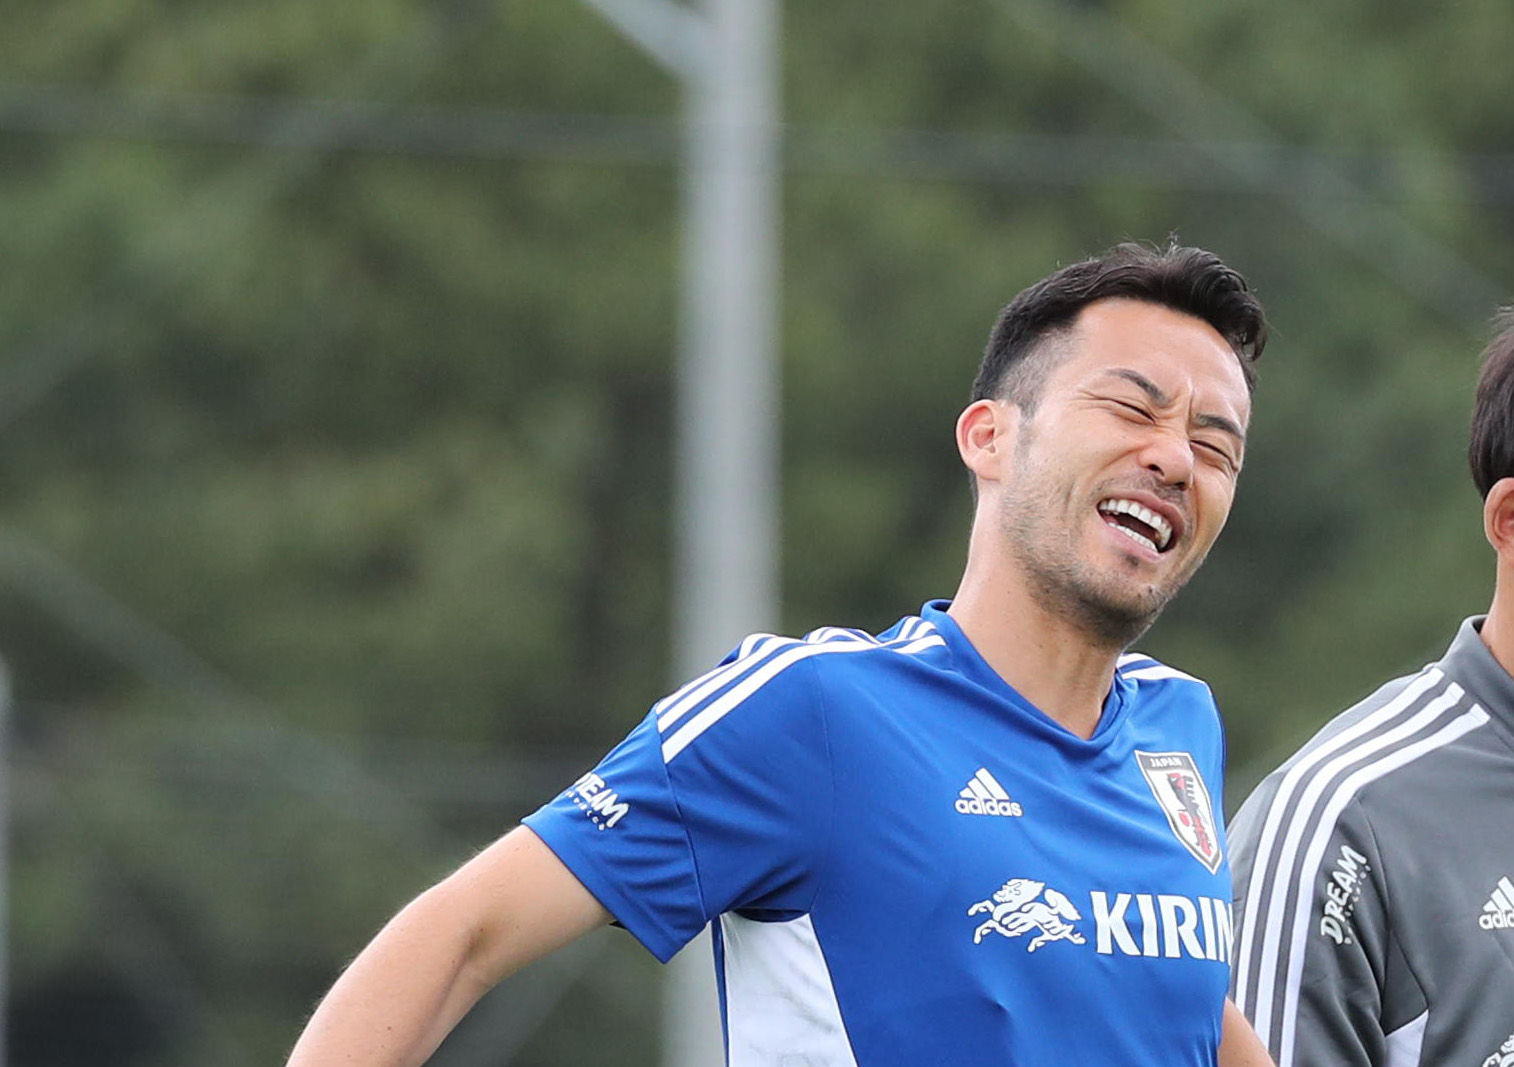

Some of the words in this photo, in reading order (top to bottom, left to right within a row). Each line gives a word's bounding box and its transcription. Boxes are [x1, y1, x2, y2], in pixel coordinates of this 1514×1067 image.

[1149, 757, 1183, 768] JAPAN
[955, 798, 1023, 817] adidas
[1320, 844, 1367, 945] DREAM
